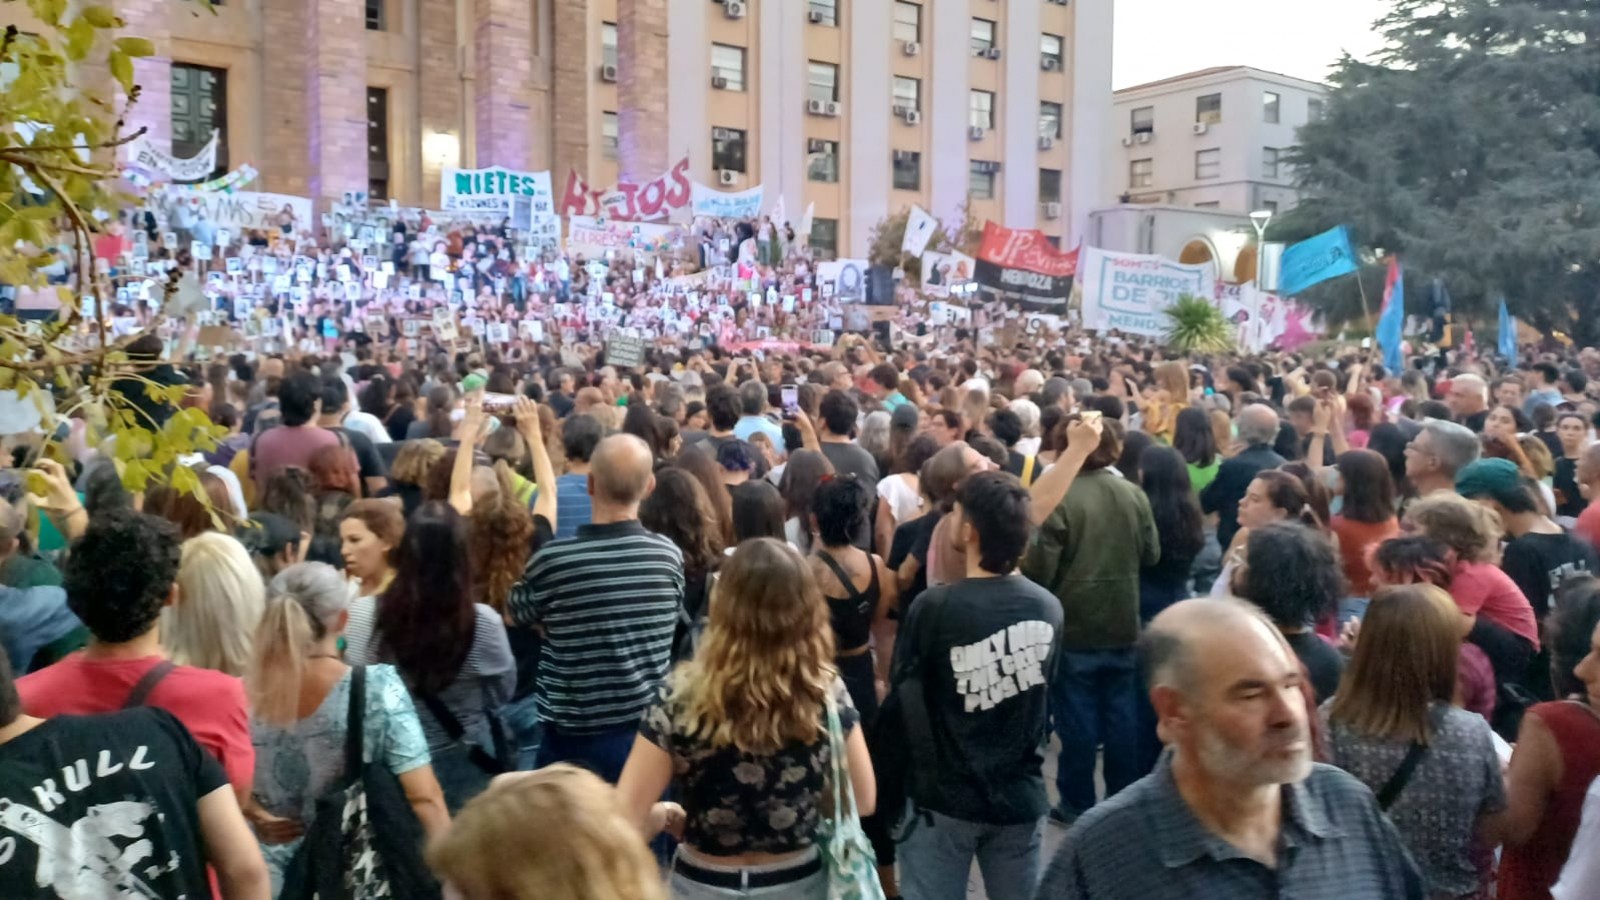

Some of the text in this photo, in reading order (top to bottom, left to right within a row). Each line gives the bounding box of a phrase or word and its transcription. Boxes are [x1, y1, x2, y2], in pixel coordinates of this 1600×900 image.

[455, 170, 535, 196] NIETES
[988, 230, 1035, 265] JP
[1000, 268, 1053, 291] MENDOZA
[1113, 270, 1192, 291] BARRIOS
[1111, 285, 1147, 304] DE
